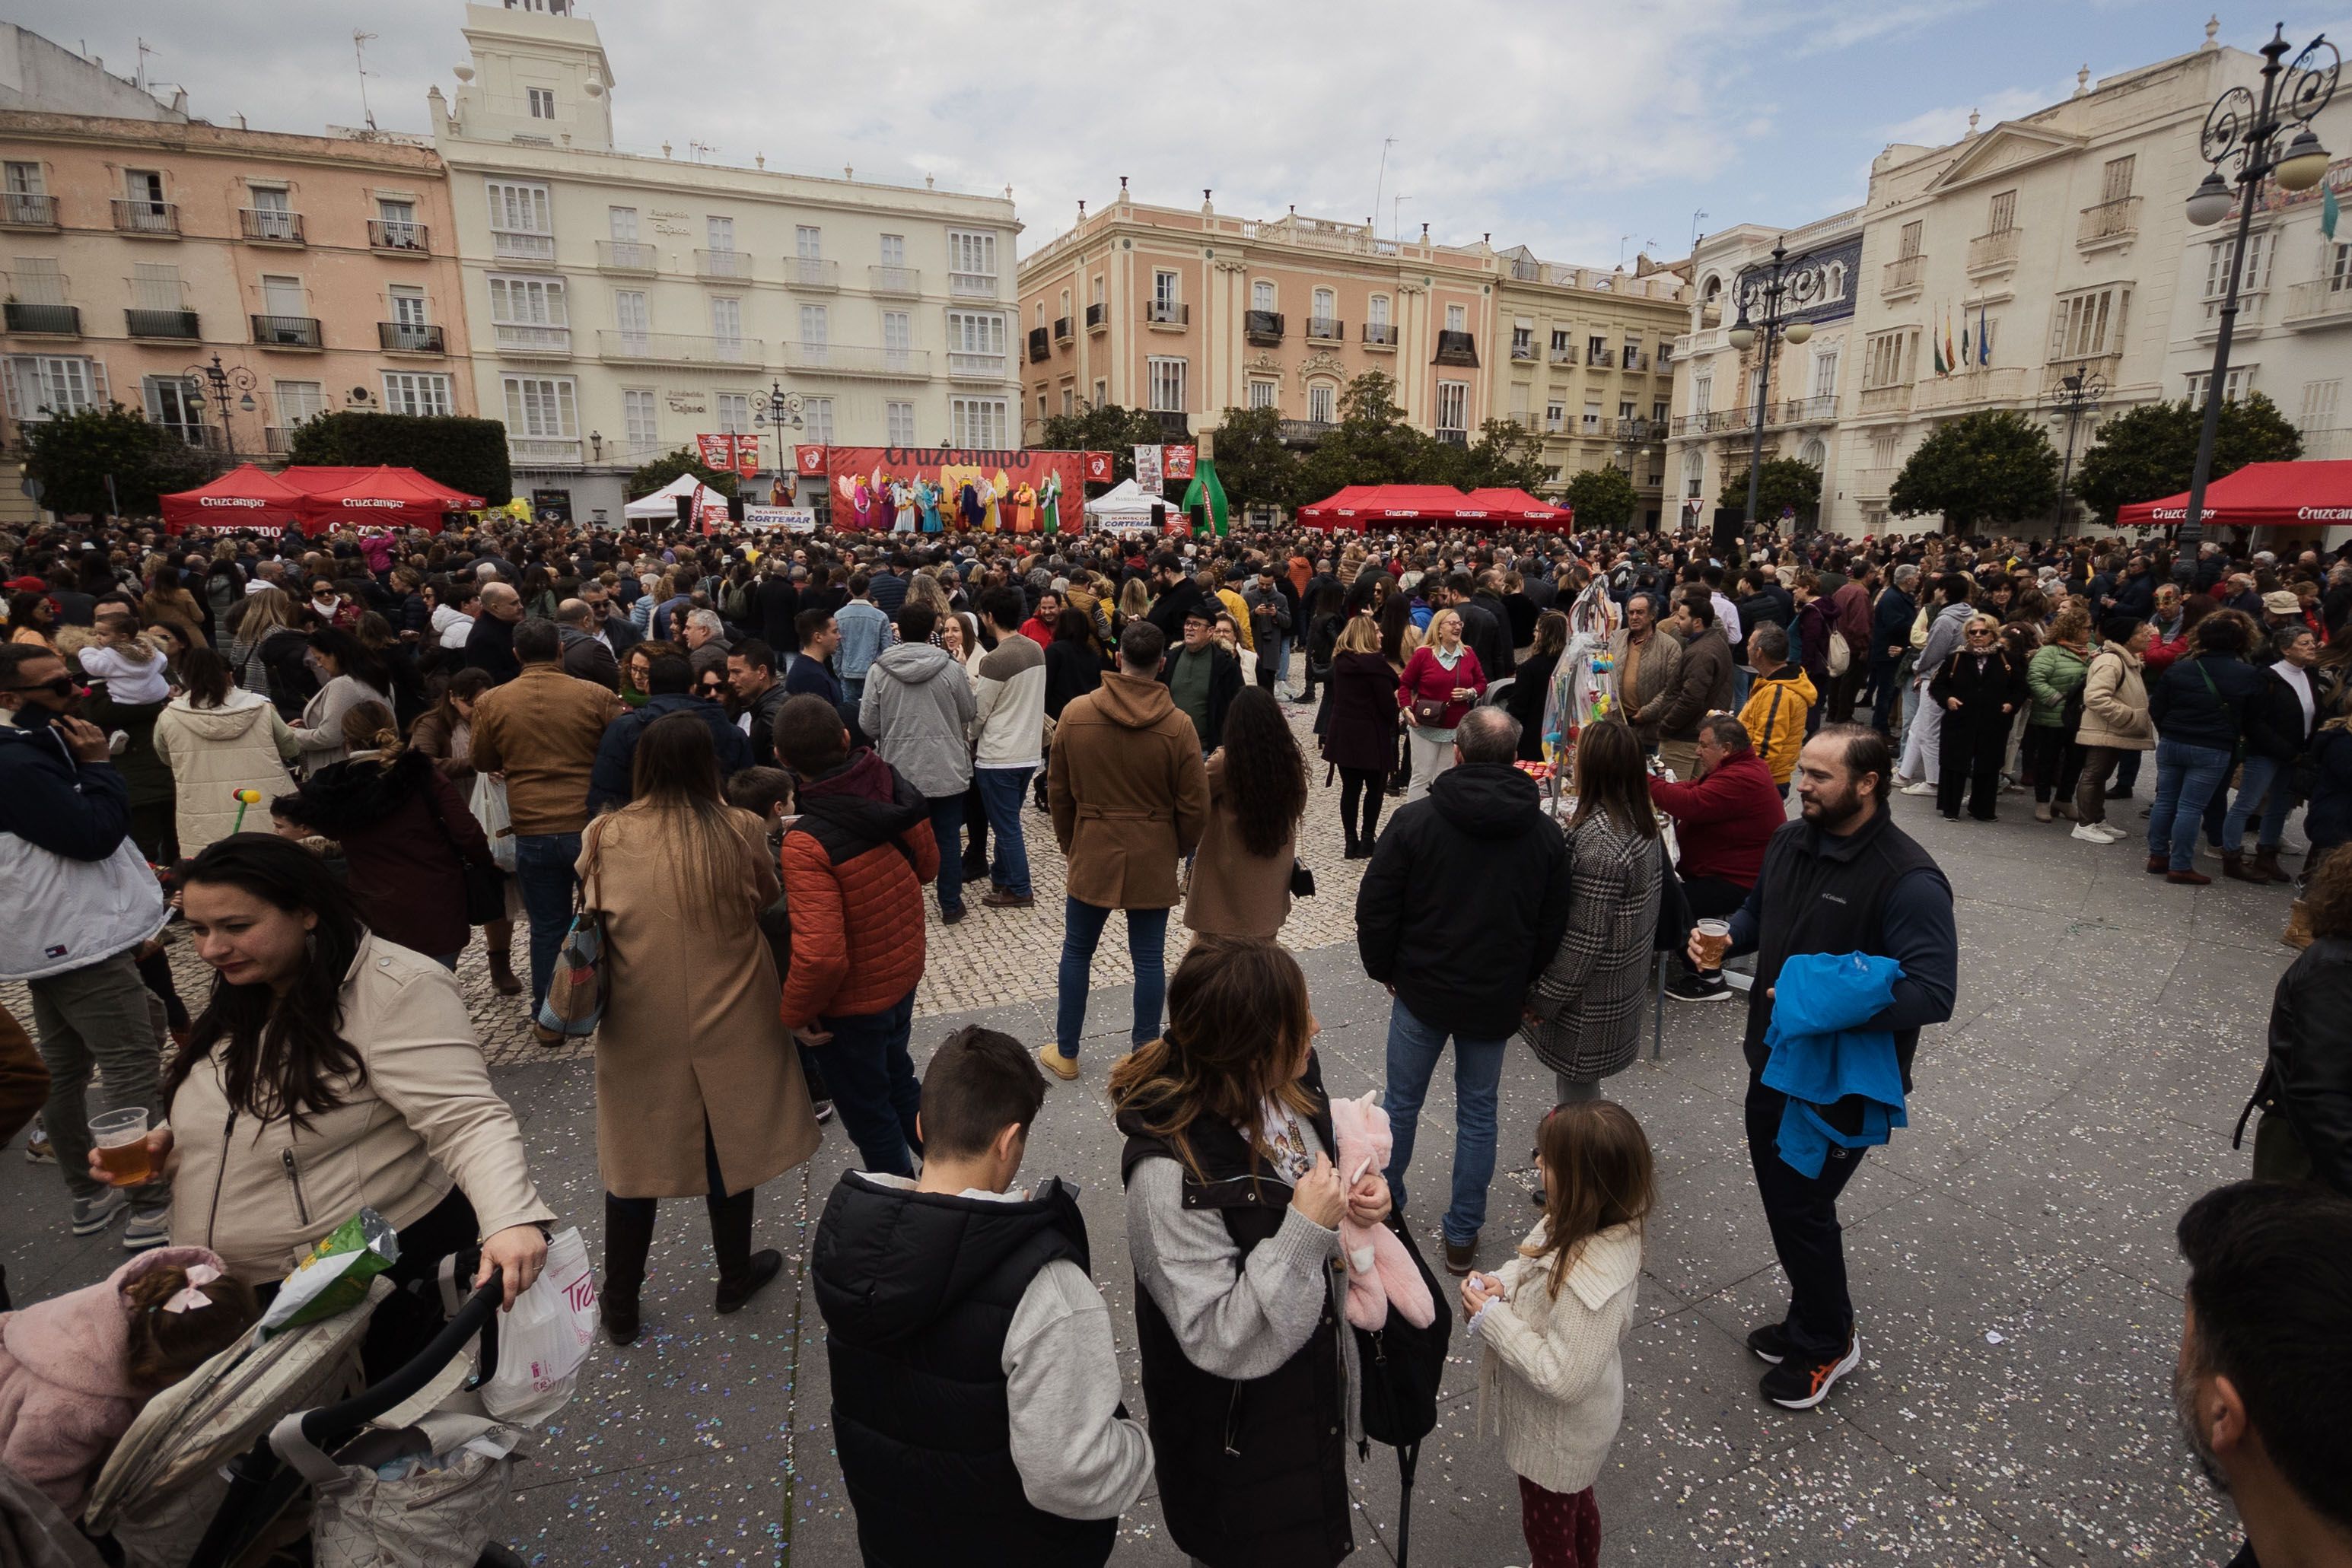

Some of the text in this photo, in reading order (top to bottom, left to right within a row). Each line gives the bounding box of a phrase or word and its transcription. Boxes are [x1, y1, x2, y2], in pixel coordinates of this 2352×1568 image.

[653, 223, 691, 237] Cajasol
[670, 402, 706, 415] Cajasol
[200, 496, 264, 509] Cruzcampo
[342, 498, 405, 510] Cruzcampo
[746, 514, 811, 524] CORTEMAR
[2152, 507, 2216, 520] Cruzcapo
